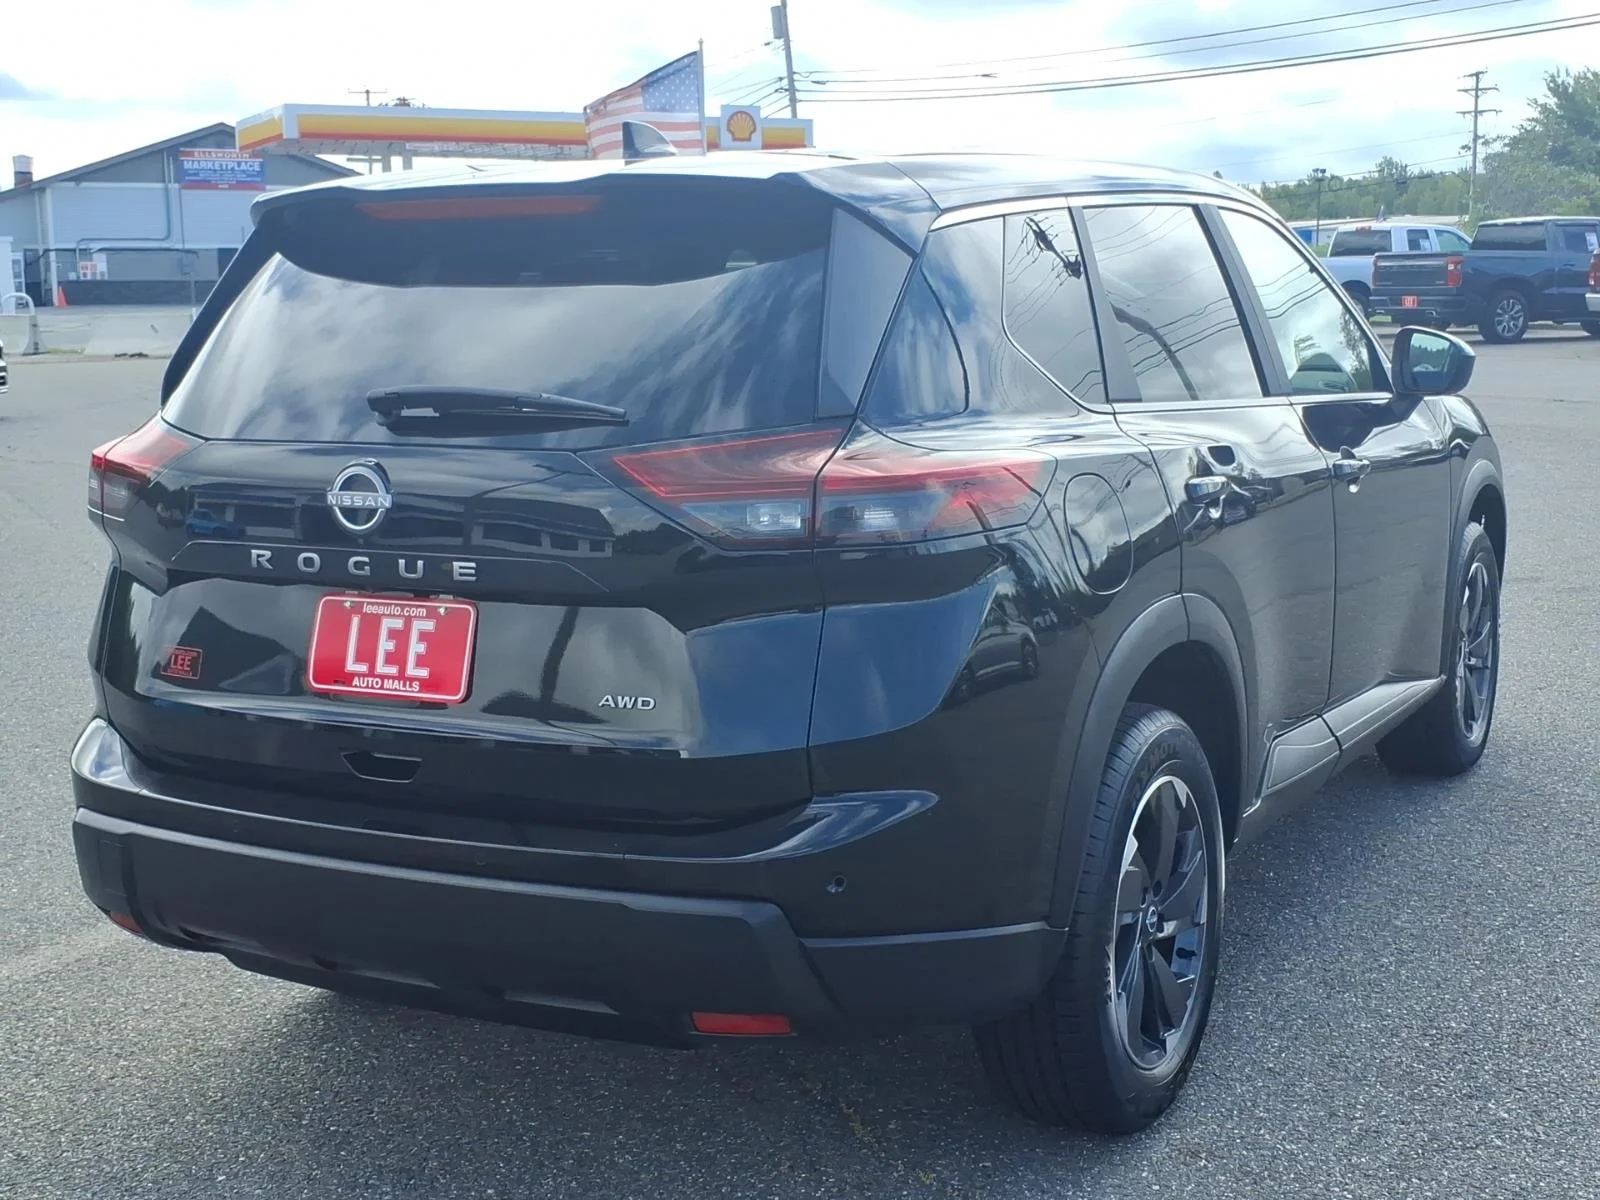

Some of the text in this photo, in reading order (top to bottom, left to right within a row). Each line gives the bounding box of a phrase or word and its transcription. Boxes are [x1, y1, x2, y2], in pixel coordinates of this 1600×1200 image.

[194, 151, 250, 159] ELLSWORTH
[183, 160, 261, 171] MARKETPLACE
[327, 494, 391, 507] NISSAN
[250, 549, 477, 582] ROGUE
[363, 602, 427, 617] leeauto.com
[345, 614, 437, 679] LEE
[170, 653, 192, 671] LEE
[352, 676, 420, 692] AUTO MALLS
[598, 694, 656, 710] AWD
